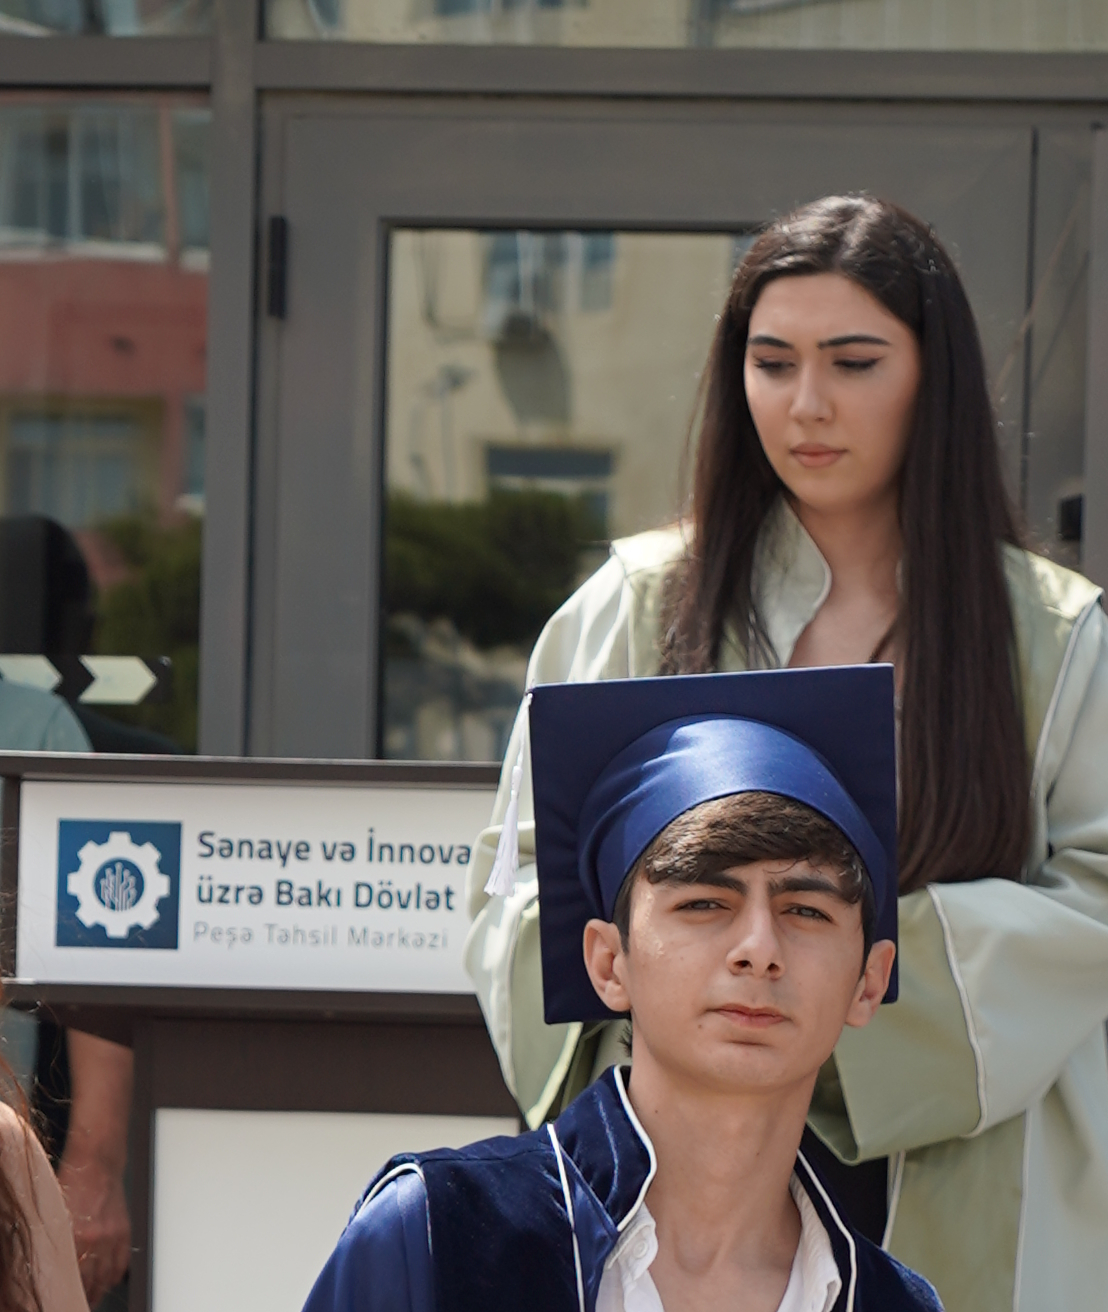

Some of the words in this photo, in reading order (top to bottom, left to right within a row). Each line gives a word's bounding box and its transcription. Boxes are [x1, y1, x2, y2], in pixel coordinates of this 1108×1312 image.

[198, 831, 310, 868] Sənaye
[321, 842, 356, 862] və
[197, 876, 263, 905] üzrə
[276, 879, 341, 907] Bakı
[354, 881, 454, 911] Dövlət
[194, 921, 253, 949] Peşə
[264, 923, 337, 946] Təhsil
[348, 926, 447, 950] Mərkəzi
